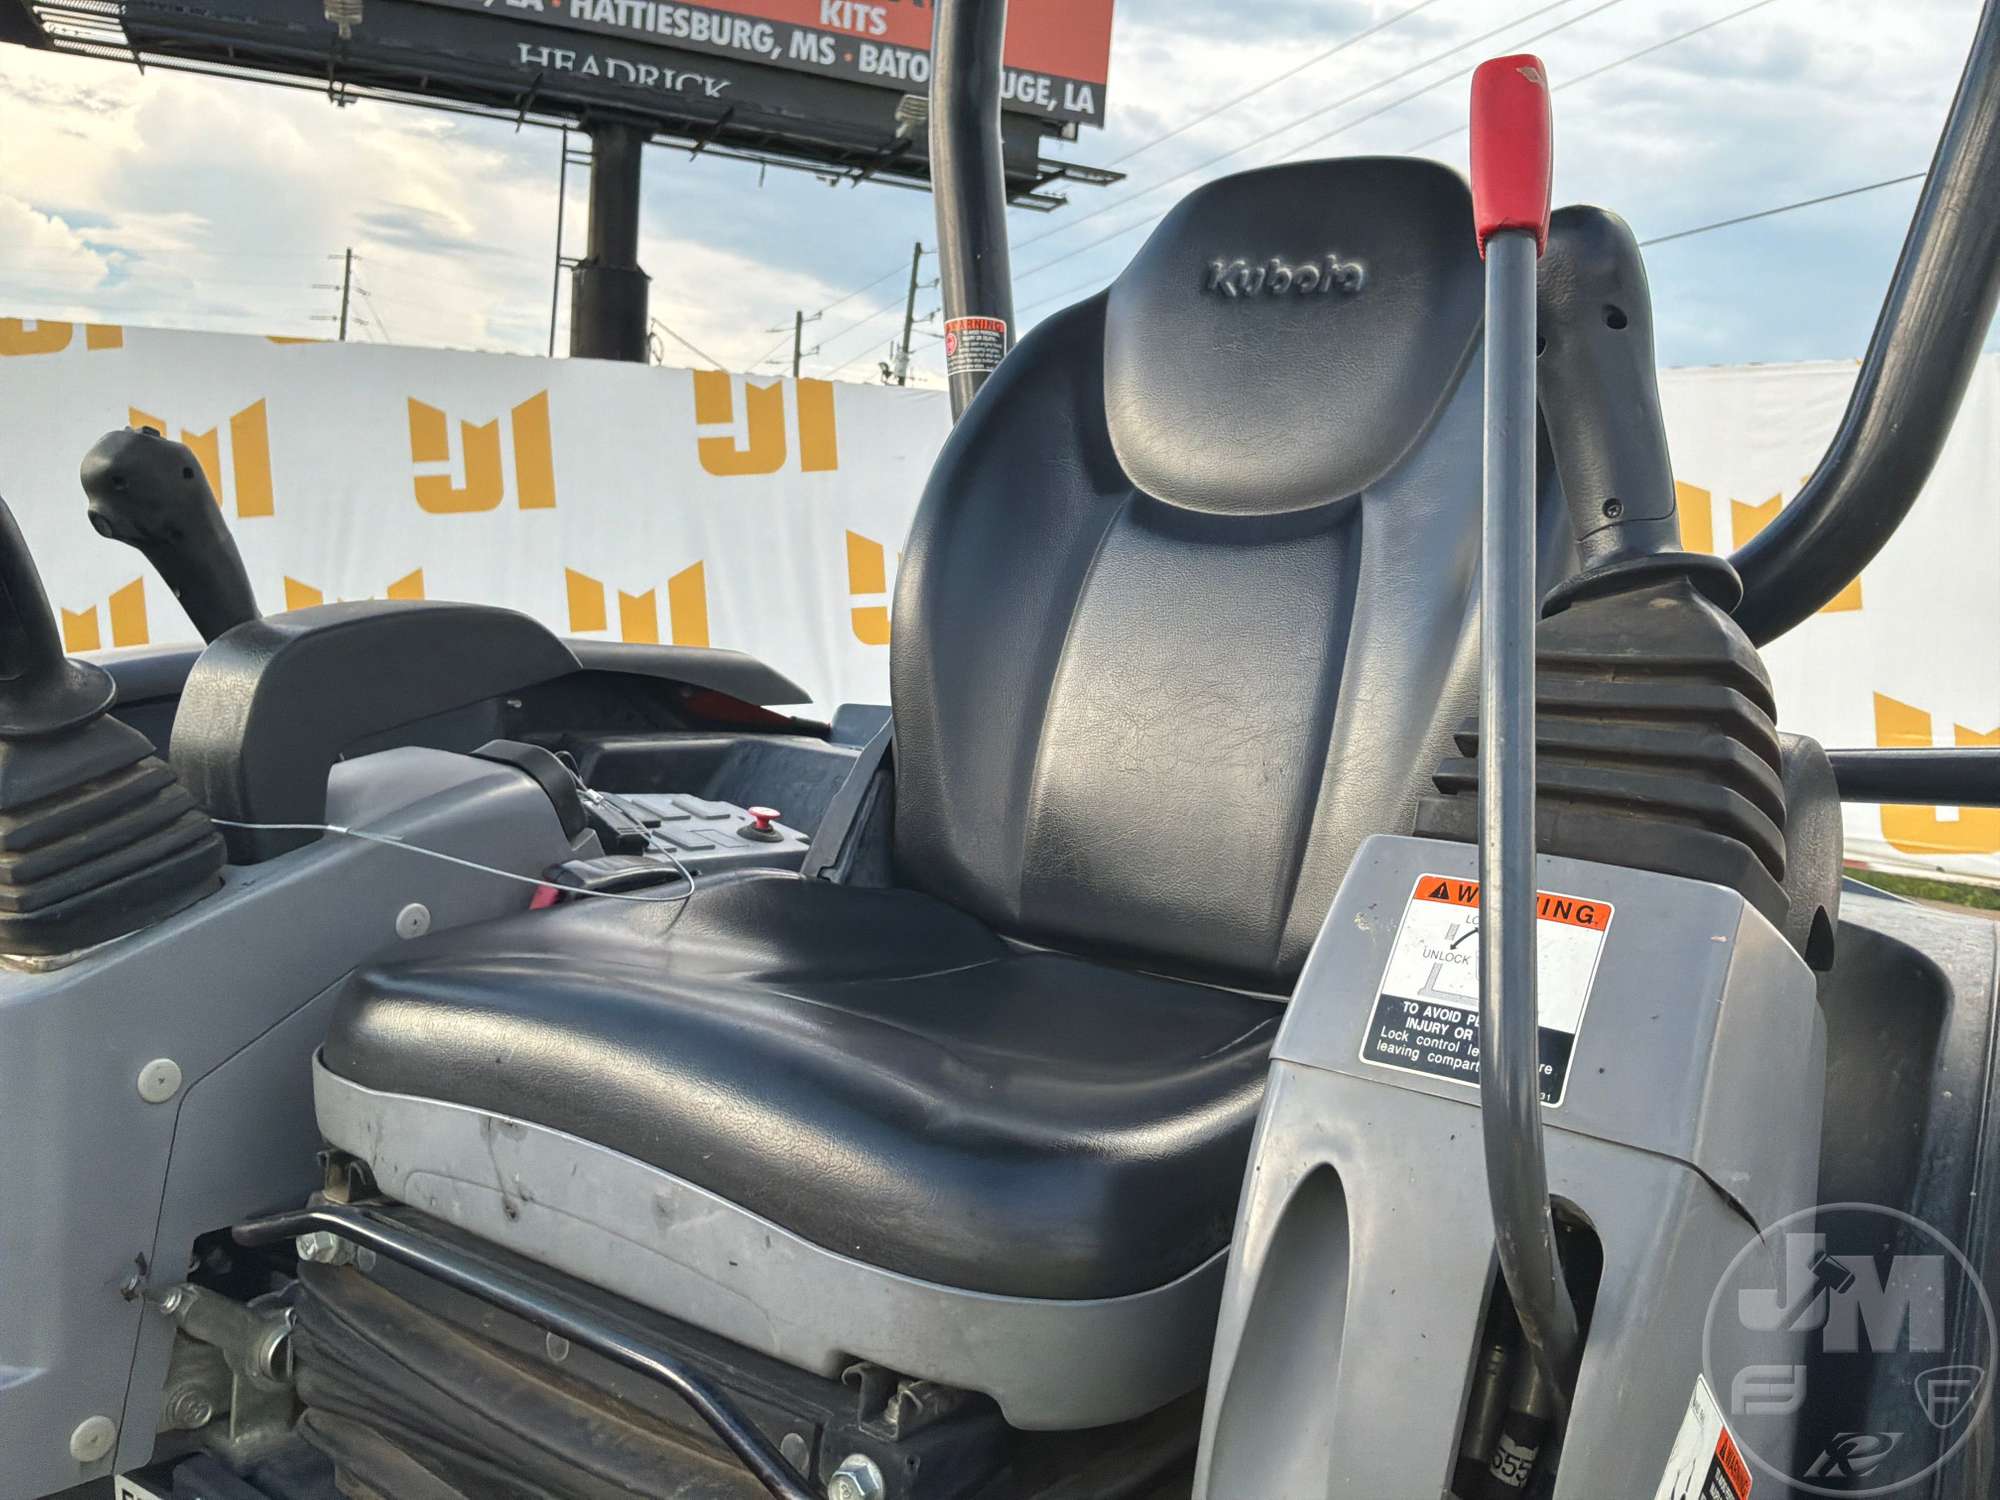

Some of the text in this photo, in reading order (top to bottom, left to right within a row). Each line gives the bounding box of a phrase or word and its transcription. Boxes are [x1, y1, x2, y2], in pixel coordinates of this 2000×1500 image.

[819, 0, 888, 36] KITS
[569, 0, 1096, 115] HATTIESBURG, MS BATO UGE, LA
[1205, 253, 1367, 298] Kubota
[1457, 884, 1596, 925] WING
[1422, 947, 1472, 966] UNLOCK
[1403, 1001, 1420, 1015] TO
[1423, 1006, 1462, 1024] AVOID
[1405, 1016, 1449, 1036] INJURY
[1454, 1027, 1474, 1042] OR
[1376, 1039, 1480, 1073] leaving compart
[1381, 1025, 1409, 1042] Lock
[1416, 1034, 1460, 1053] control
